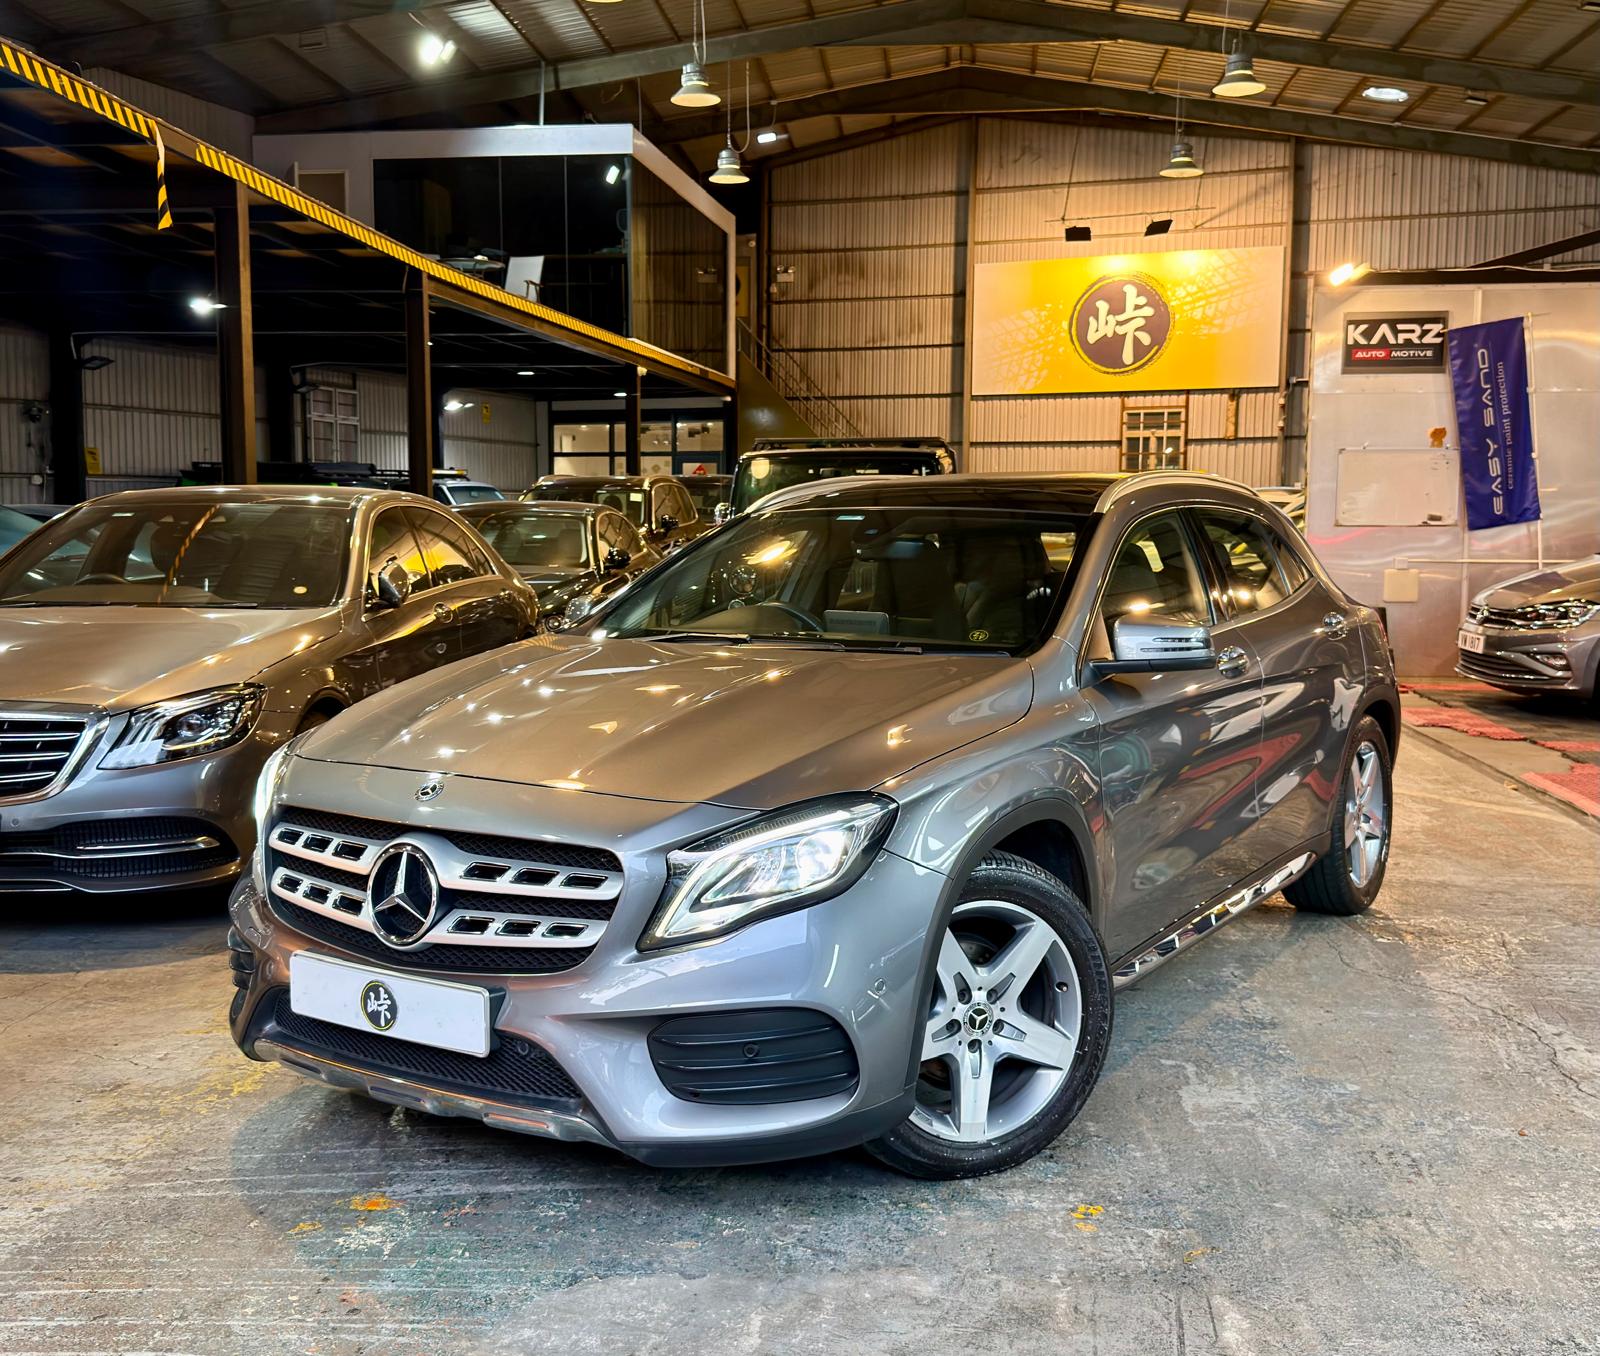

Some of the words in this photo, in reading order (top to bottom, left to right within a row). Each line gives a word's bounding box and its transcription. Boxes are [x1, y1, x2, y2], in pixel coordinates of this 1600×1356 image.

[1087, 284, 1155, 365] 峠
[1347, 323, 1444, 345] KARZ
[1354, 350, 1386, 358] AUTO
[1477, 348, 1495, 427] SAND
[1496, 361, 1512, 416] protection
[1502, 417, 1513, 445] paint
[1486, 438, 1504, 515] EASY
[1505, 448, 1514, 490] ceramic
[367, 987, 391, 1026] 峠
